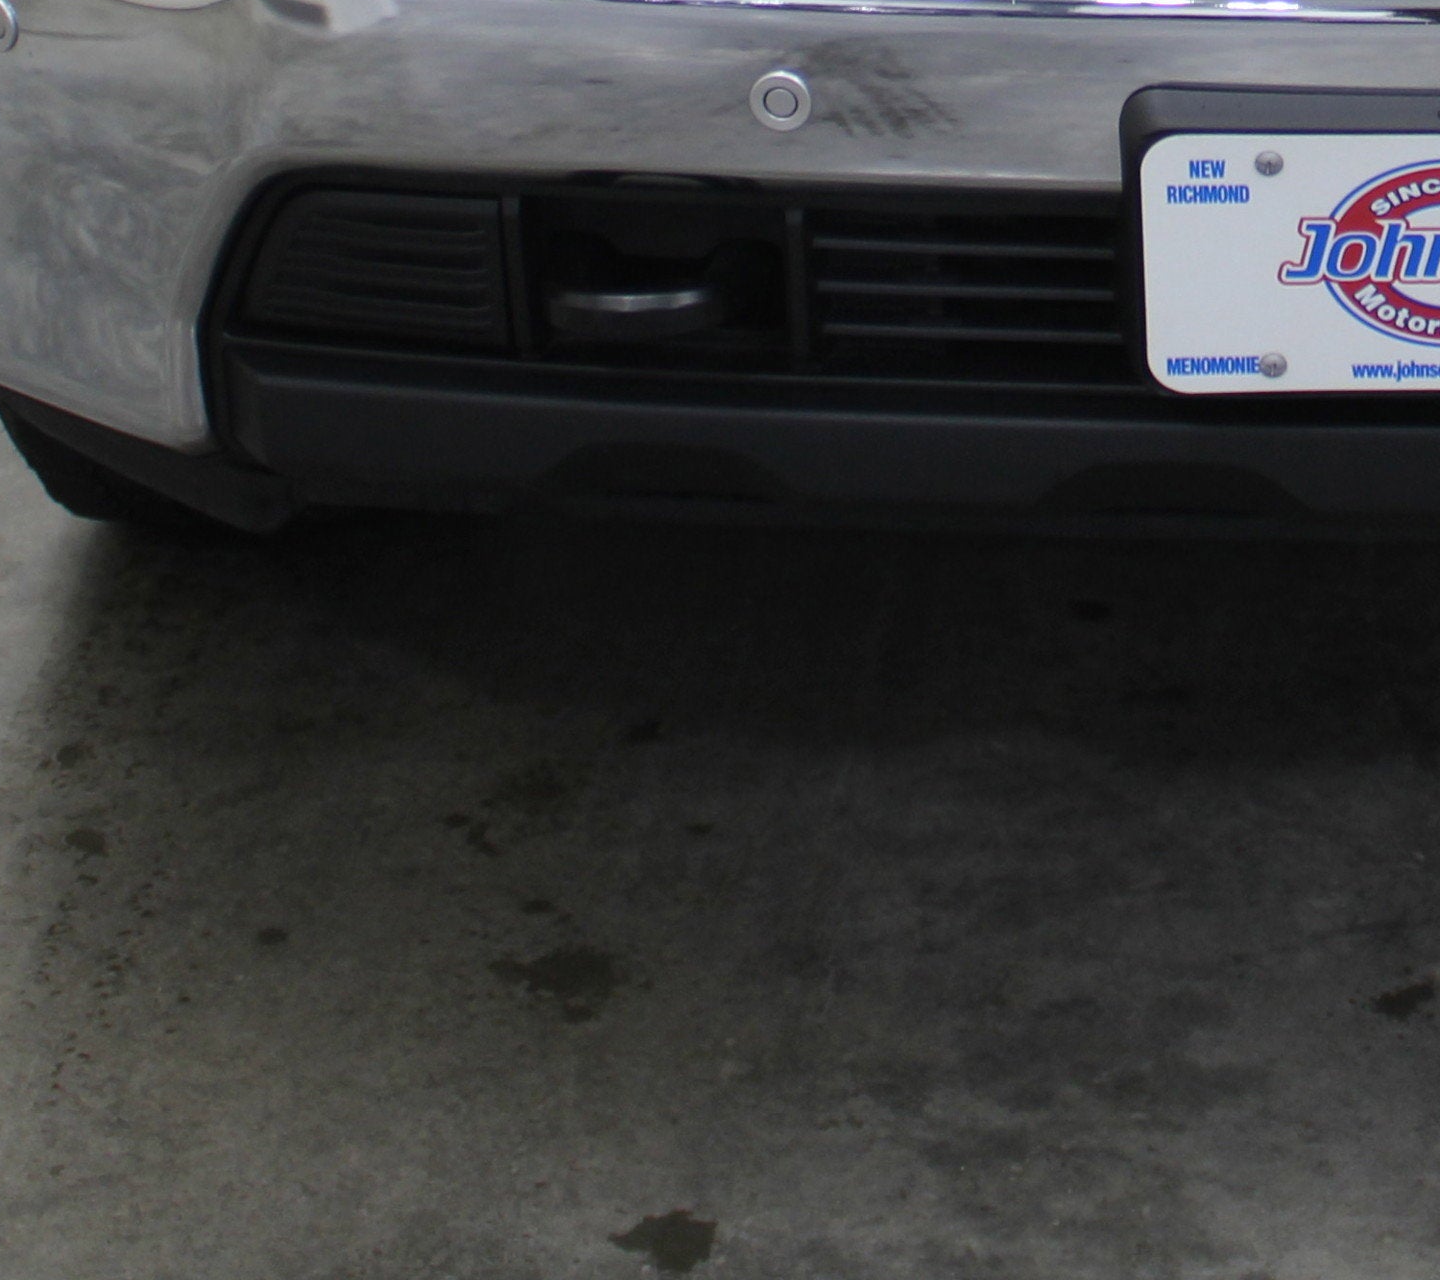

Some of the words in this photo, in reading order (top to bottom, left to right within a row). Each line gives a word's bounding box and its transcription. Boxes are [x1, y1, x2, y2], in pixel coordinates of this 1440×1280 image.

[1188, 159, 1226, 179] NEW
[1166, 184, 1250, 204] RICHMOND
[1166, 356, 1260, 375] MENOMONIE
